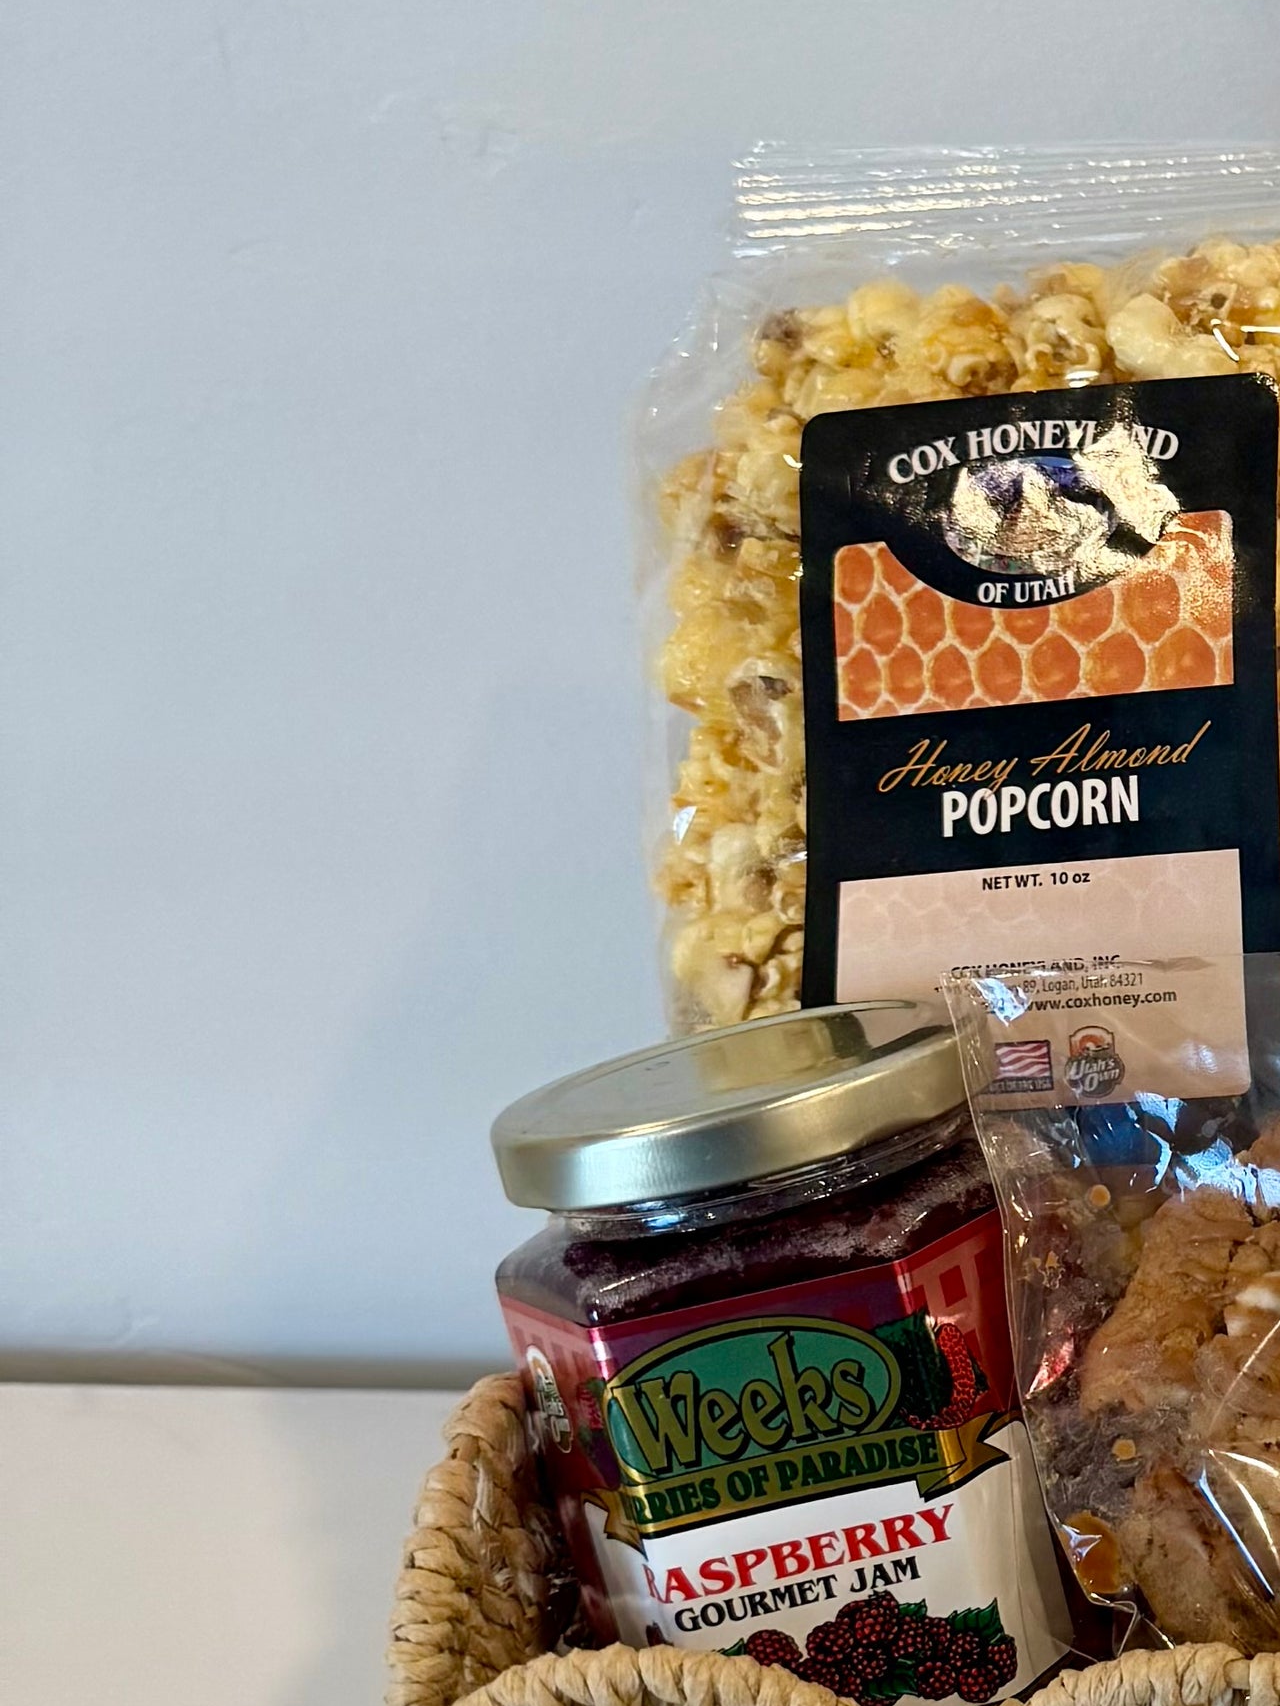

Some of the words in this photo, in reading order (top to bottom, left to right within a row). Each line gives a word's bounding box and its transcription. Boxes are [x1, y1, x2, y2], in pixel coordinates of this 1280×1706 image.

[888, 435, 960, 484] COX
[967, 419, 1179, 461] HONEYLND
[978, 581, 1004, 604] OF
[1013, 572, 1076, 603] UTAH
[878, 738, 1018, 800] Honey
[1030, 719, 1211, 777] Almond
[941, 775, 1139, 838] POPCORN
[982, 876, 1012, 891] NET
[1014, 873, 1043, 888] WT.
[1050, 872, 1069, 885] 10
[1072, 871, 1091, 885] oz
[1042, 977, 1079, 994] Logan,
[1109, 973, 1143, 987] 84321
[1069, 1058, 1115, 1080] Utah's
[1084, 1069, 1120, 1092] Own
[612, 1331, 875, 1474] Weeks
[727, 1464, 770, 1502] OF
[774, 1431, 940, 1491] PARADISE
[642, 1503, 954, 1605] RASPBERRY
[674, 1574, 839, 1633] GOURMET
[849, 1555, 922, 1593] JAM
